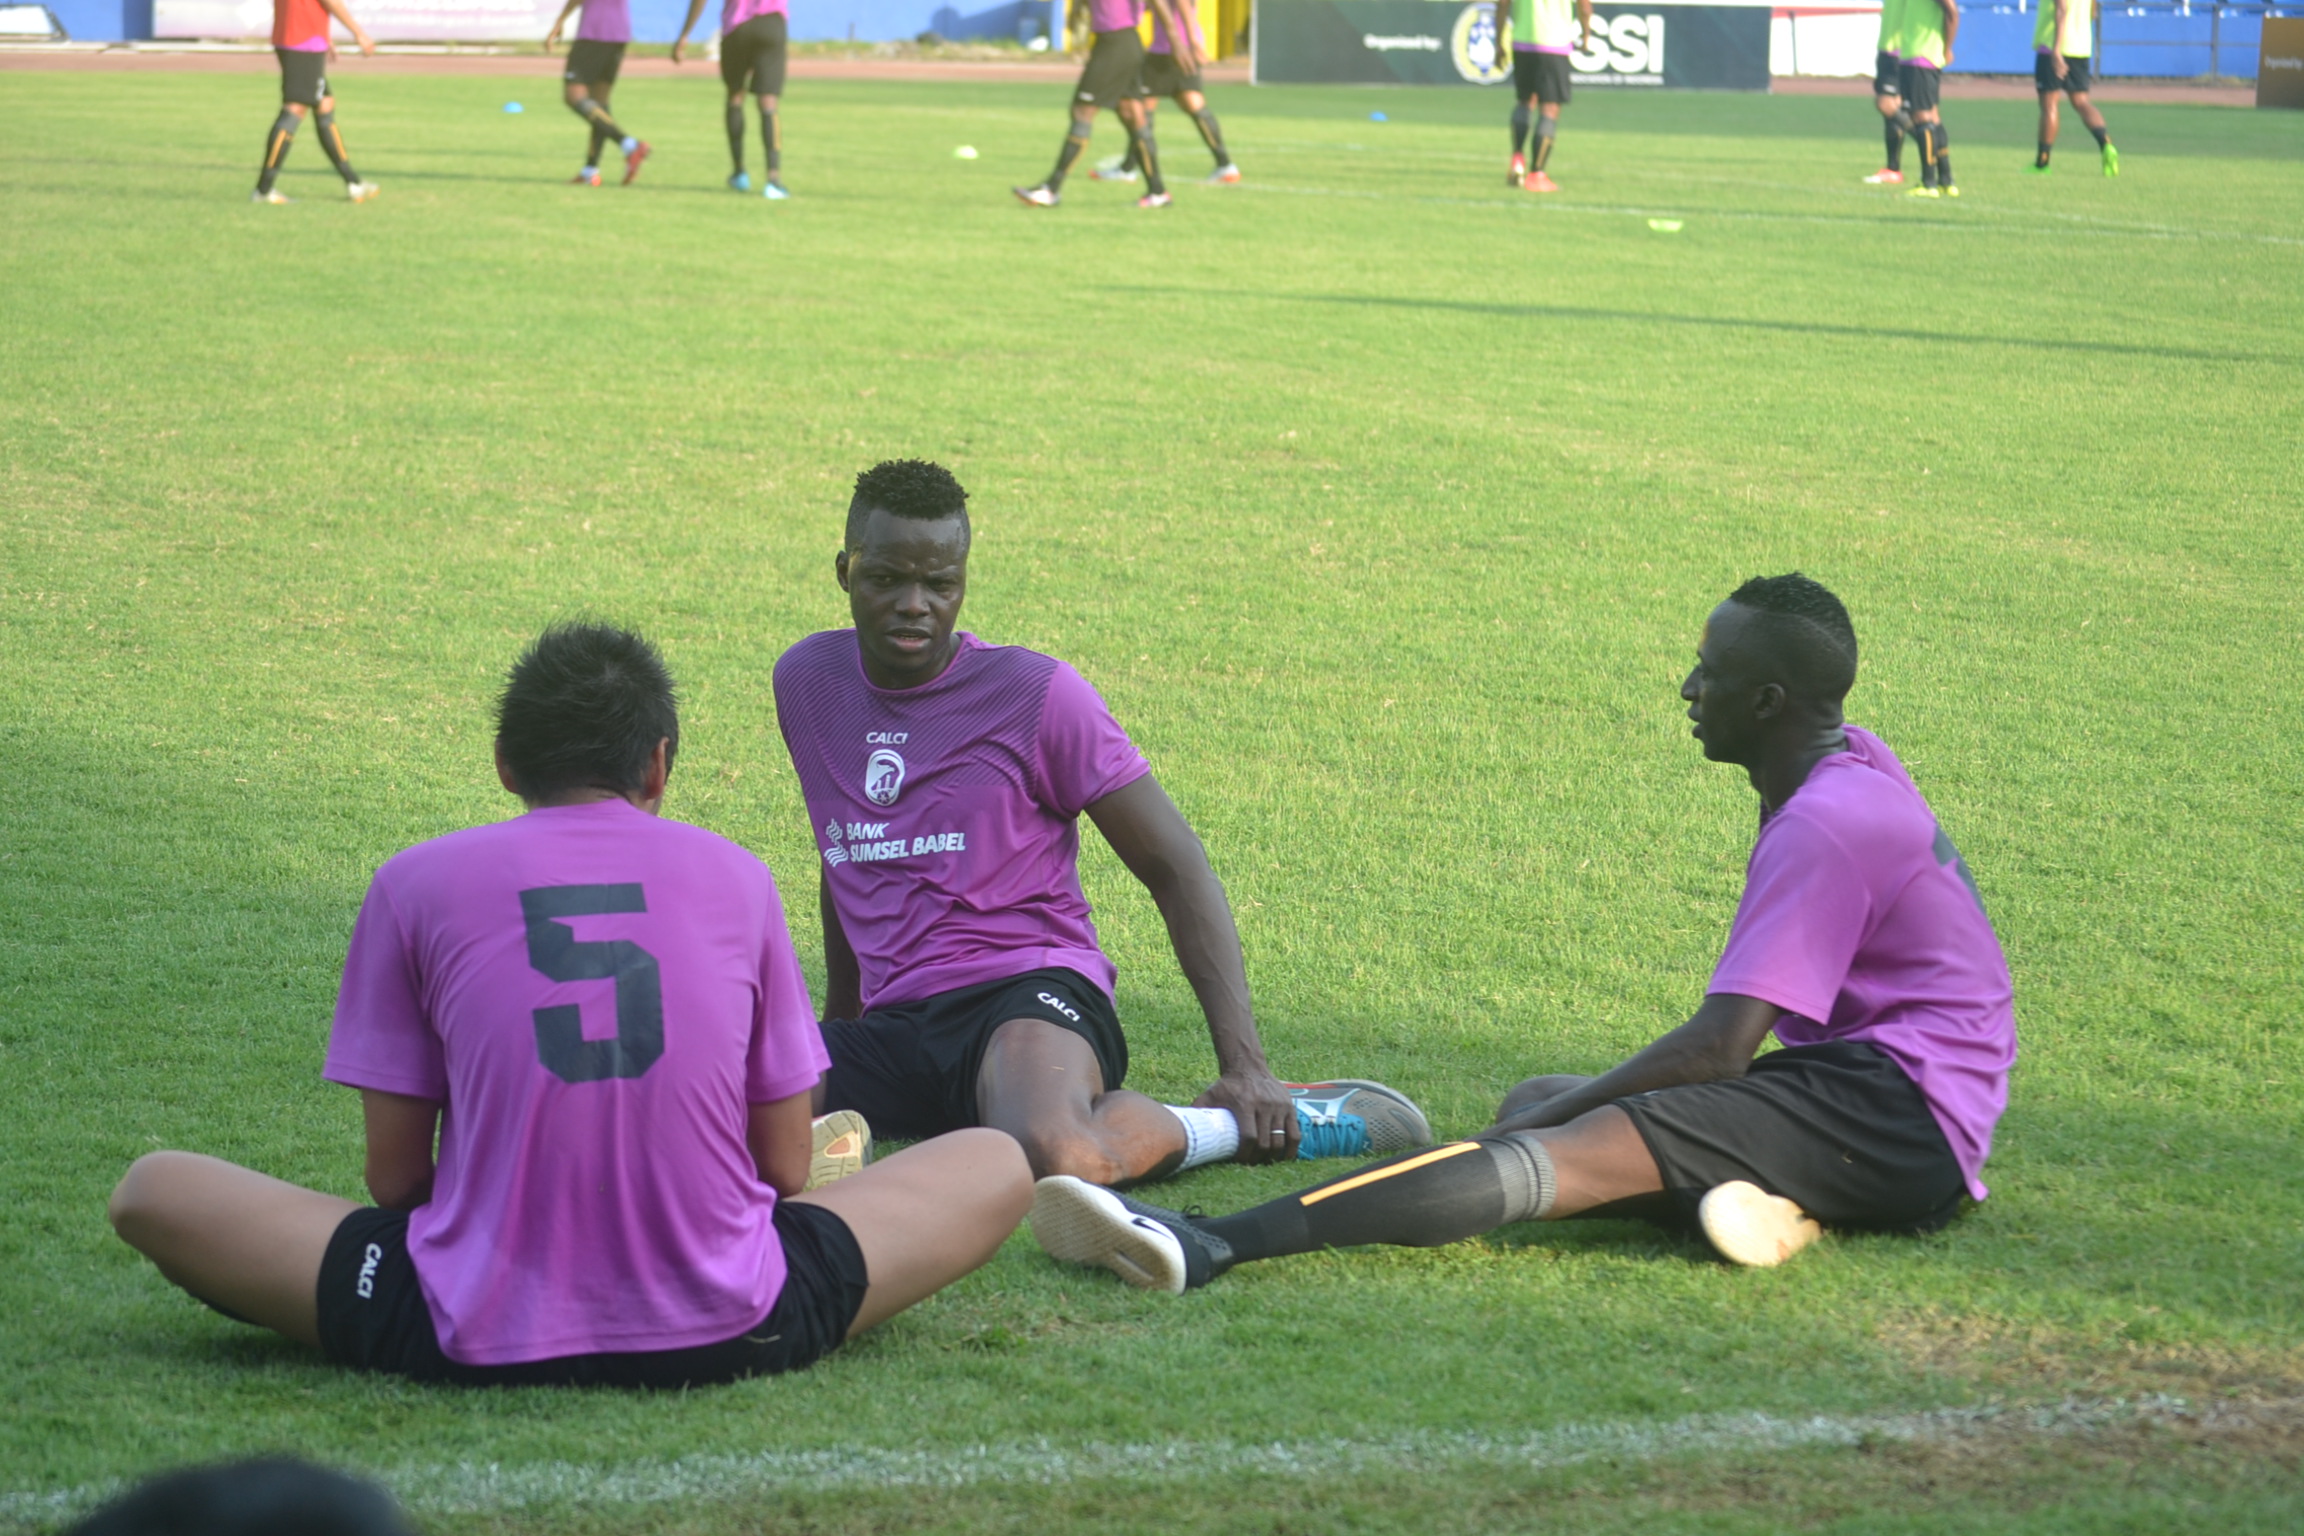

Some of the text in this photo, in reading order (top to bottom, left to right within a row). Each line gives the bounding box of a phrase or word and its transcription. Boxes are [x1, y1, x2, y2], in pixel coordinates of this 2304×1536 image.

[1568, 13, 1665, 74] SSI
[865, 731, 909, 745] CALCI
[846, 822, 890, 841] BANK
[850, 832, 966, 862] SUMSEL BABEL
[518, 882, 665, 1084] 5
[1037, 992, 1081, 1022] CALCI
[356, 1242, 382, 1299] CALCI
